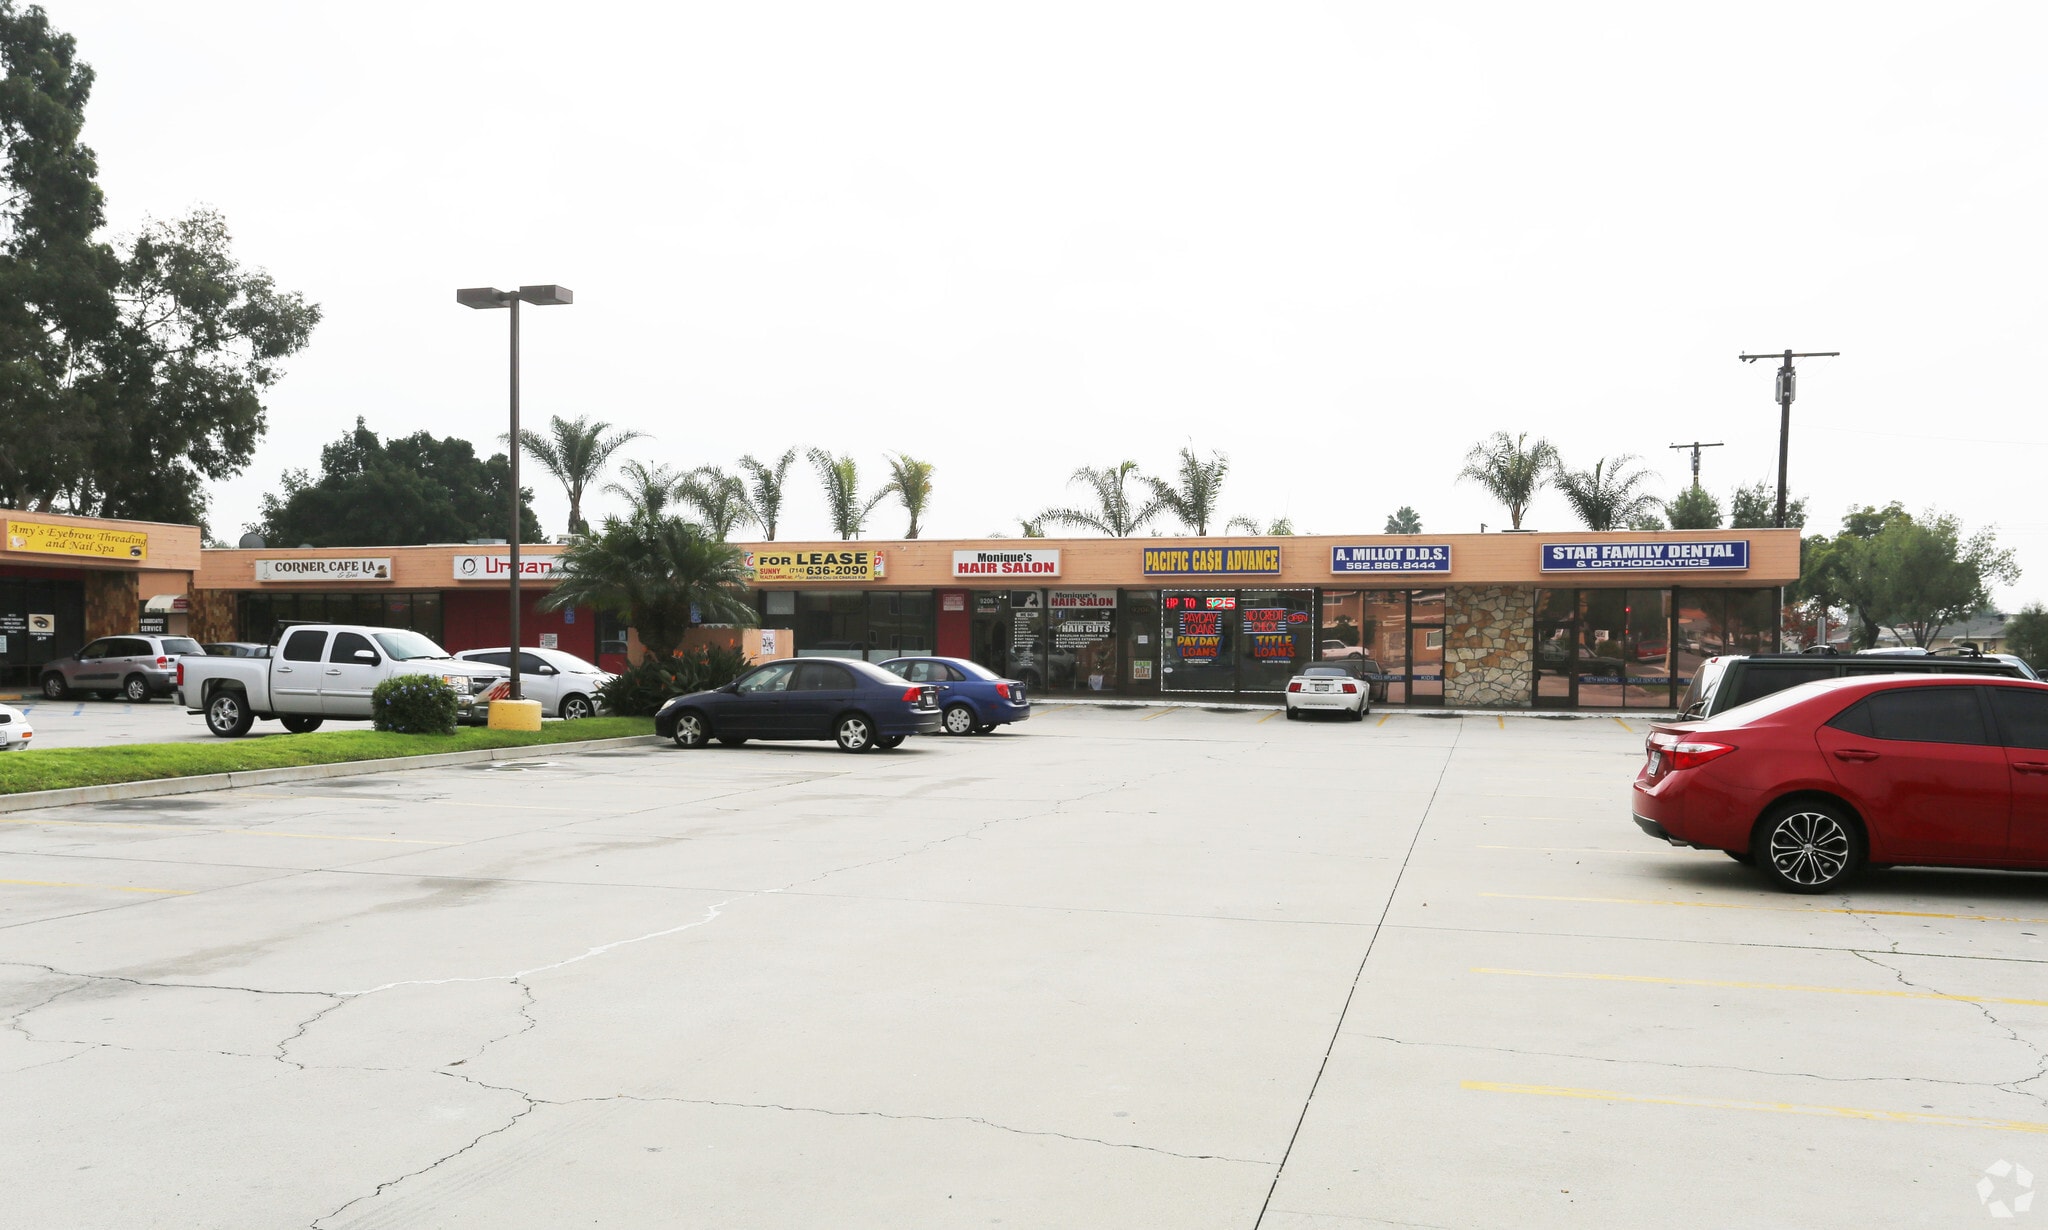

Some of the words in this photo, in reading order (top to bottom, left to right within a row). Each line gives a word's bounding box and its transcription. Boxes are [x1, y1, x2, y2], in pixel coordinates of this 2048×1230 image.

[8, 524, 44, 538] Amy's
[47, 527, 95, 540] Eyebrow
[97, 532, 147, 547] Threading
[45, 540, 65, 549] and
[69, 542, 92, 551] Nail
[94, 543, 115, 554] Spa
[1553, 546, 1597, 560] STAR
[1602, 545, 1665, 559] FAMILY
[1668, 544, 1734, 558] DENTAL
[760, 556, 791, 565] FOR
[796, 552, 868, 565] LEASE
[977, 552, 1033, 563] Monique's
[1336, 548, 1350, 561] A.
[1352, 548, 1403, 561] MILLOT
[1406, 547, 1446, 560] D.D.S.
[1145, 550, 1189, 571] PACIFIC
[1226, 550, 1278, 571] ADVANCE
[1346, 561, 1436, 570] 562.866.8444
[1591, 558, 1710, 567] ORTHODONTICS
[275, 561, 328, 573] CORNER
[328, 561, 359, 572] CAFE
[362, 561, 375, 573] LA
[806, 566, 868, 575] 636-2090
[957, 562, 998, 573] HAIR
[1001, 562, 1055, 573] SALON
[1055, 592, 1097, 600] Monique's
[1051, 598, 1077, 606] HAIR
[1079, 598, 1113, 606] SALON
[1166, 597, 1179, 609] UP
[1183, 597, 1197, 609] TO
[1183, 612, 1217, 624] PAYDAY
[1245, 610, 1258, 621] NO
[1259, 609, 1284, 621] CREDIT
[1287, 614, 1308, 622] OPEN
[1062, 625, 1084, 633] HAIR
[1086, 625, 1110, 633] CUTS
[1185, 624, 1215, 635] LOANS
[1252, 621, 1277, 632] CHECK
[1177, 635, 1197, 647] PAY
[1199, 635, 1220, 647] DAY
[1256, 635, 1292, 647] TITLE
[1182, 648, 1218, 657] LOANS
[1254, 647, 1296, 658] LOANS
